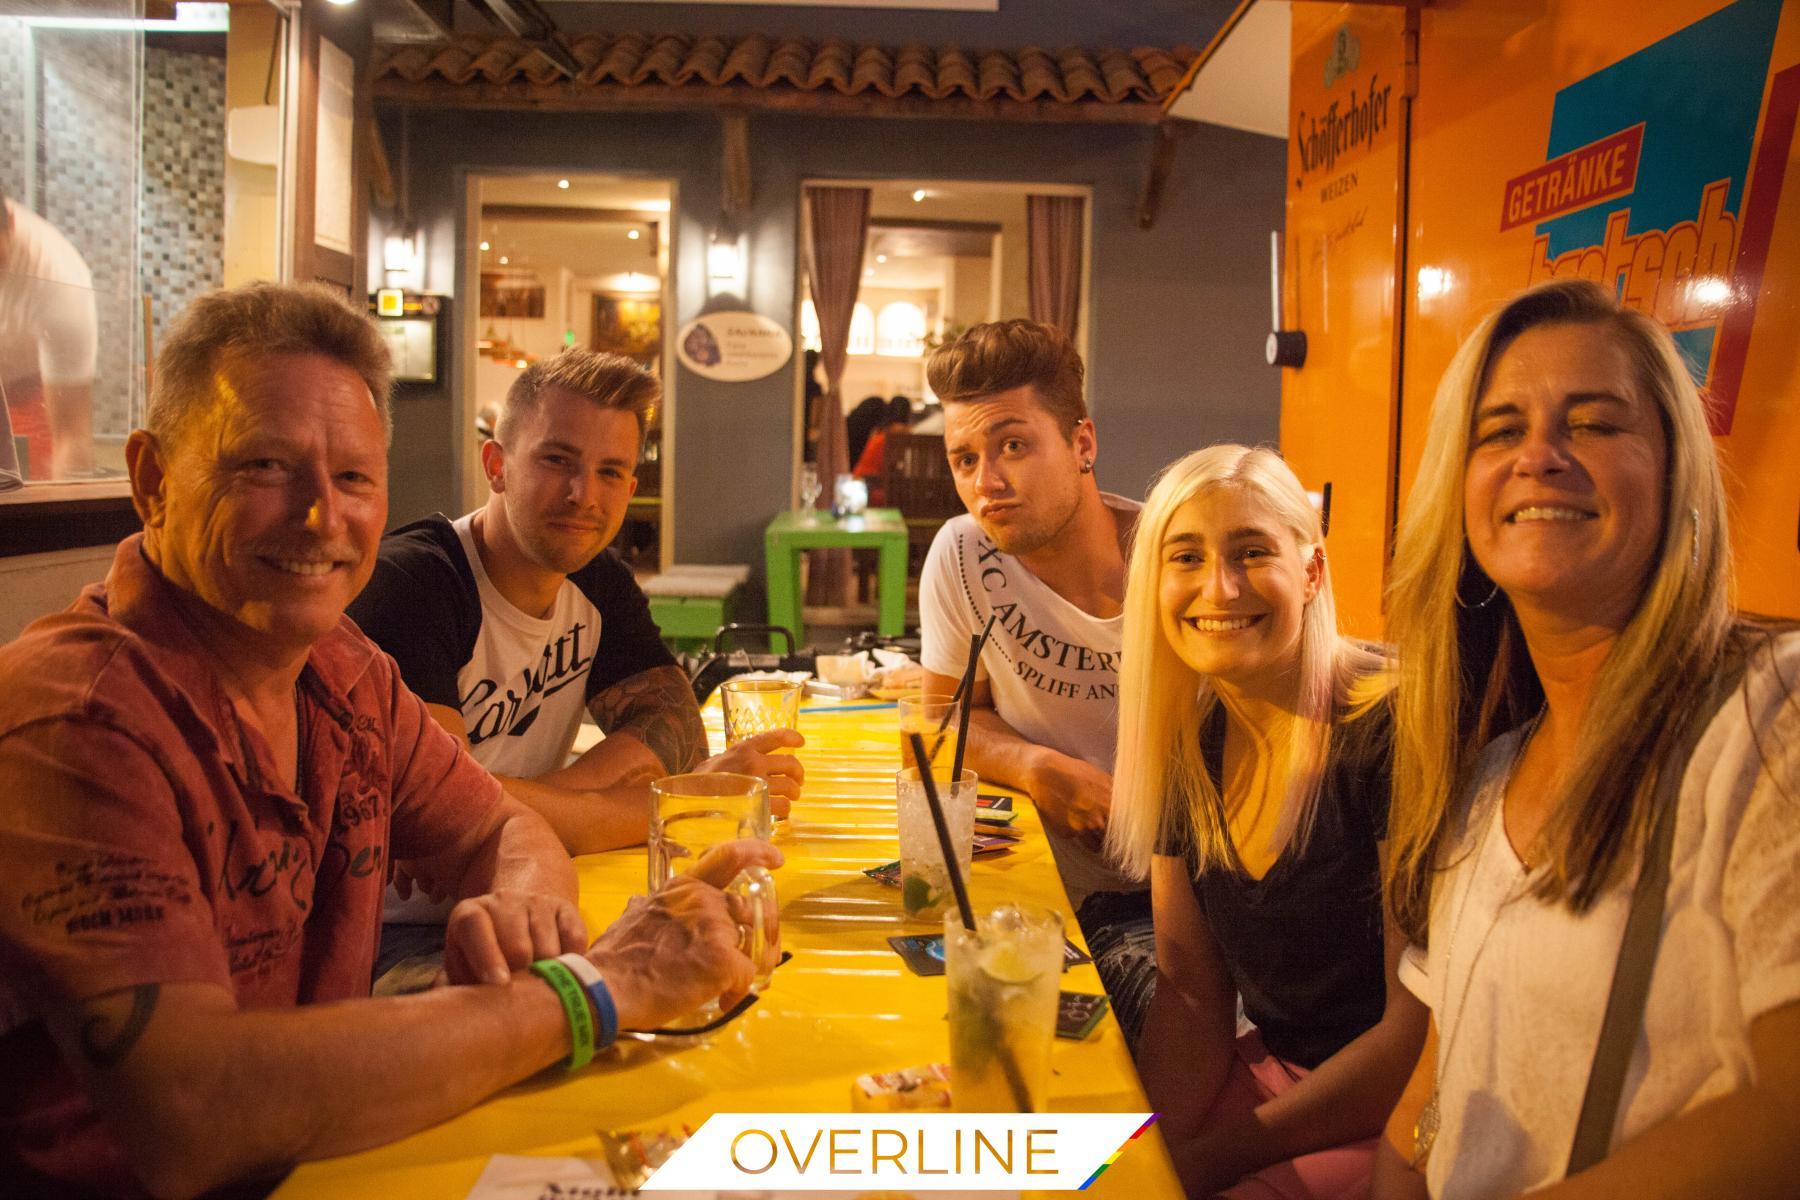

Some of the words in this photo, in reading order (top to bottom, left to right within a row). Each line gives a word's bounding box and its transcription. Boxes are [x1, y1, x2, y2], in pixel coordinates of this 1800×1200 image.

[1320, 172, 1359, 203] WEIZEN
[1508, 143, 1628, 223] GETRÄNKE
[1014, 661, 1080, 699] SPLIFF
[1086, 684, 1119, 700] AN
